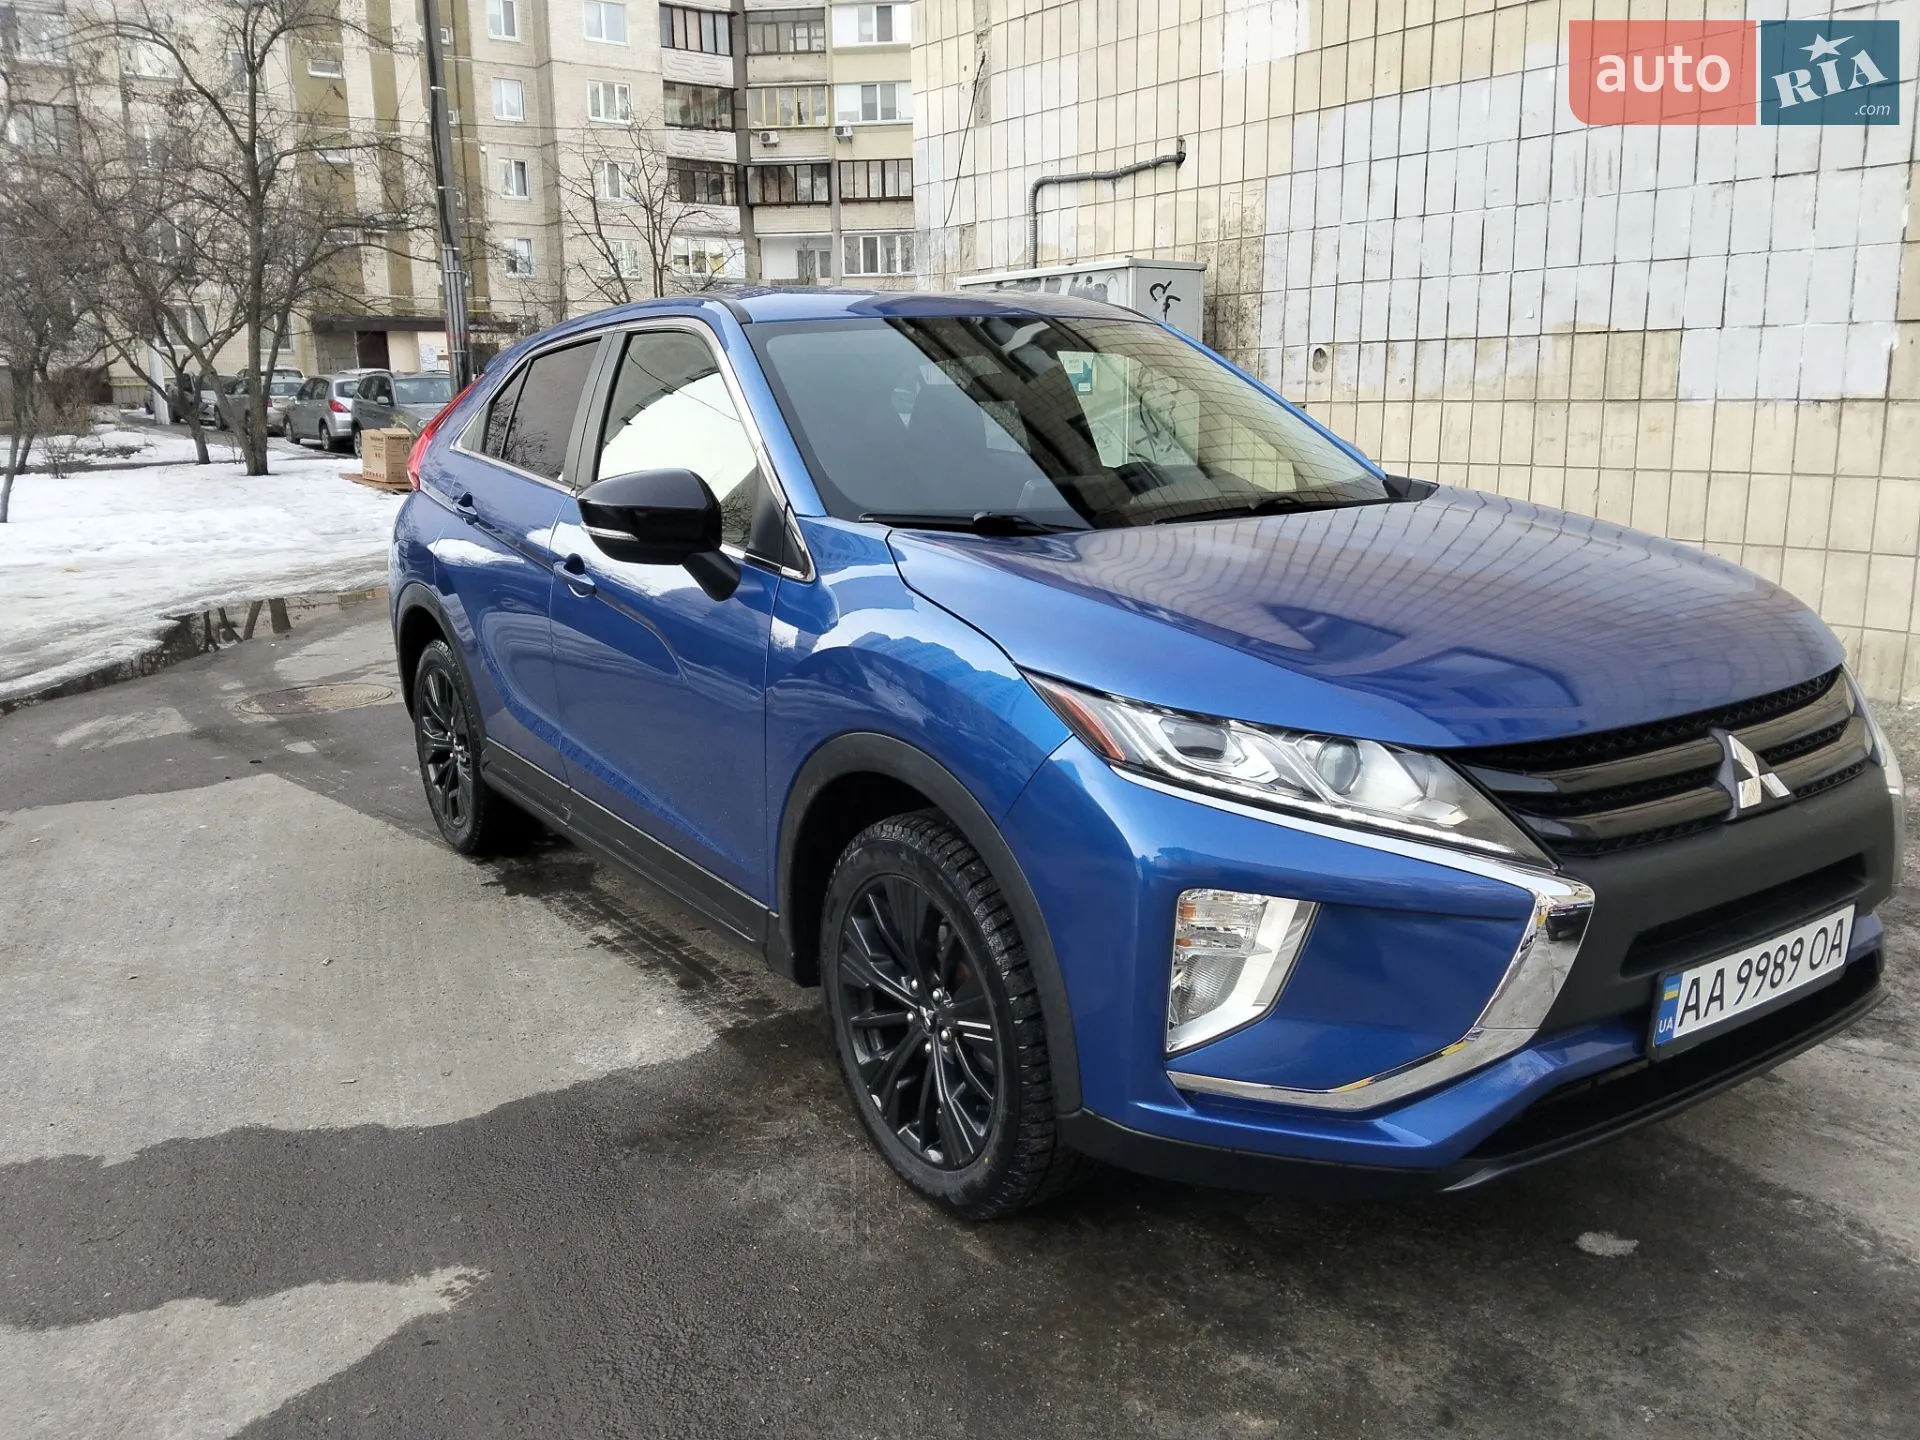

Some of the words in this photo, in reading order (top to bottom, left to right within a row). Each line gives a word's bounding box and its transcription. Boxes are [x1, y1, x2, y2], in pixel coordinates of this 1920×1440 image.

[1678, 968, 1725, 1027] AA
[1734, 937, 1804, 1006] 9989
[1809, 918, 1844, 970] OA
[1659, 1019, 1673, 1033] UA
